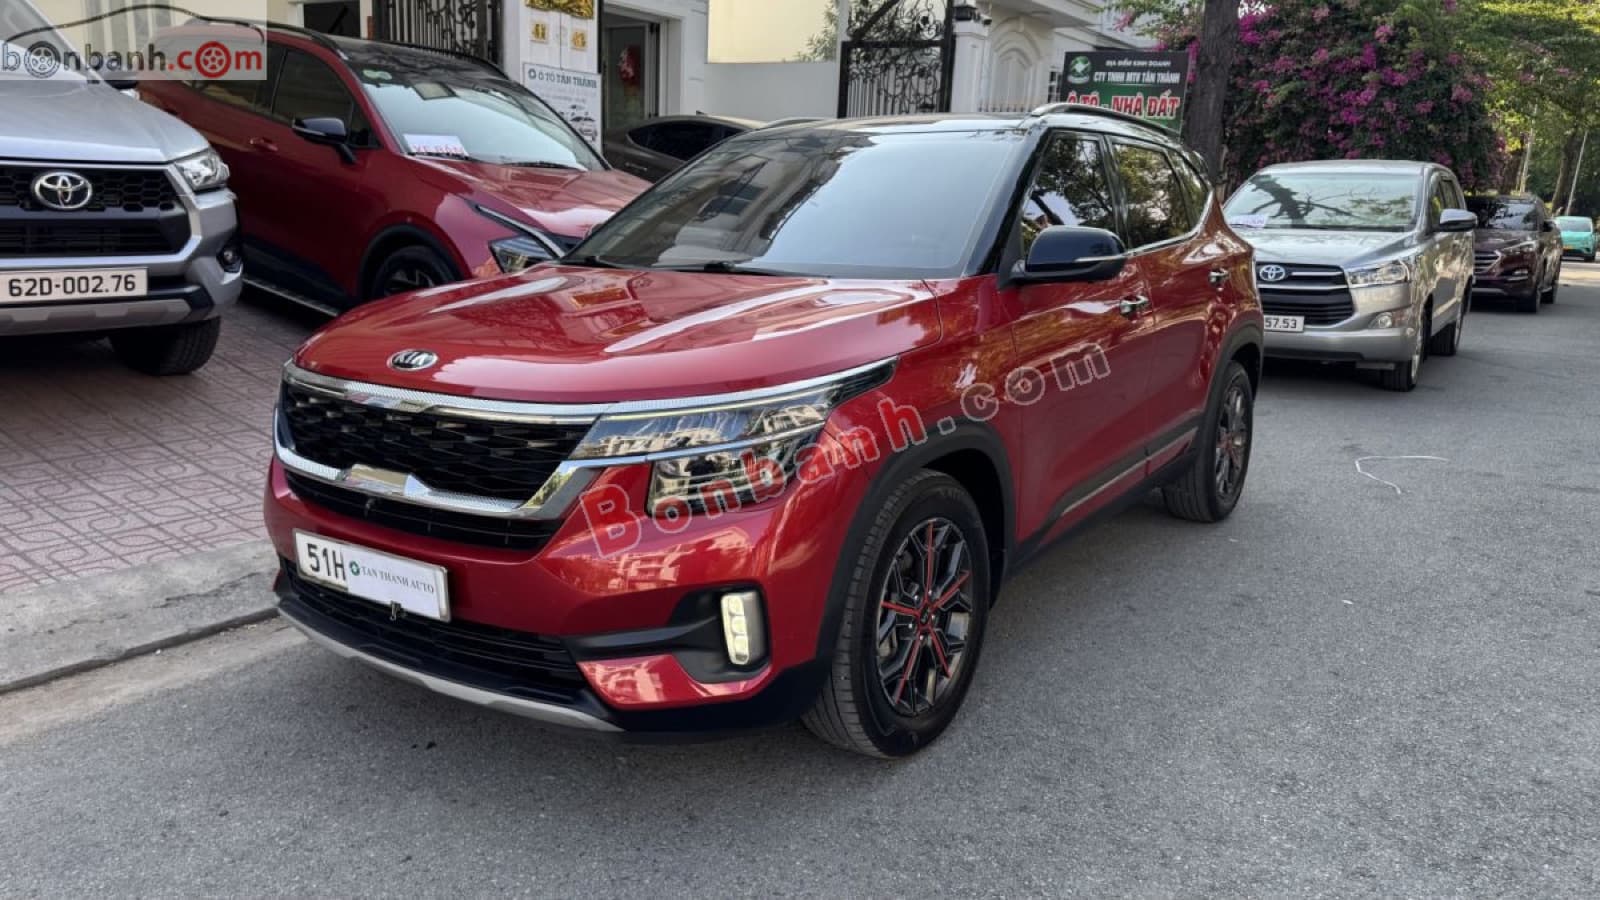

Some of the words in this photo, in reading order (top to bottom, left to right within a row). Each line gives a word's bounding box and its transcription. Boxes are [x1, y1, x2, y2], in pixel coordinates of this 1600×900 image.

[1093, 71, 1107, 83] CTY
[1111, 91, 1144, 119] NHÀ
[1147, 88, 1181, 120] ĐẤT
[8, 273, 137, 298] 62D-002.76
[391, 351, 434, 367] KIA
[306, 542, 347, 581] 51H
[409, 579, 435, 595] AUTO
